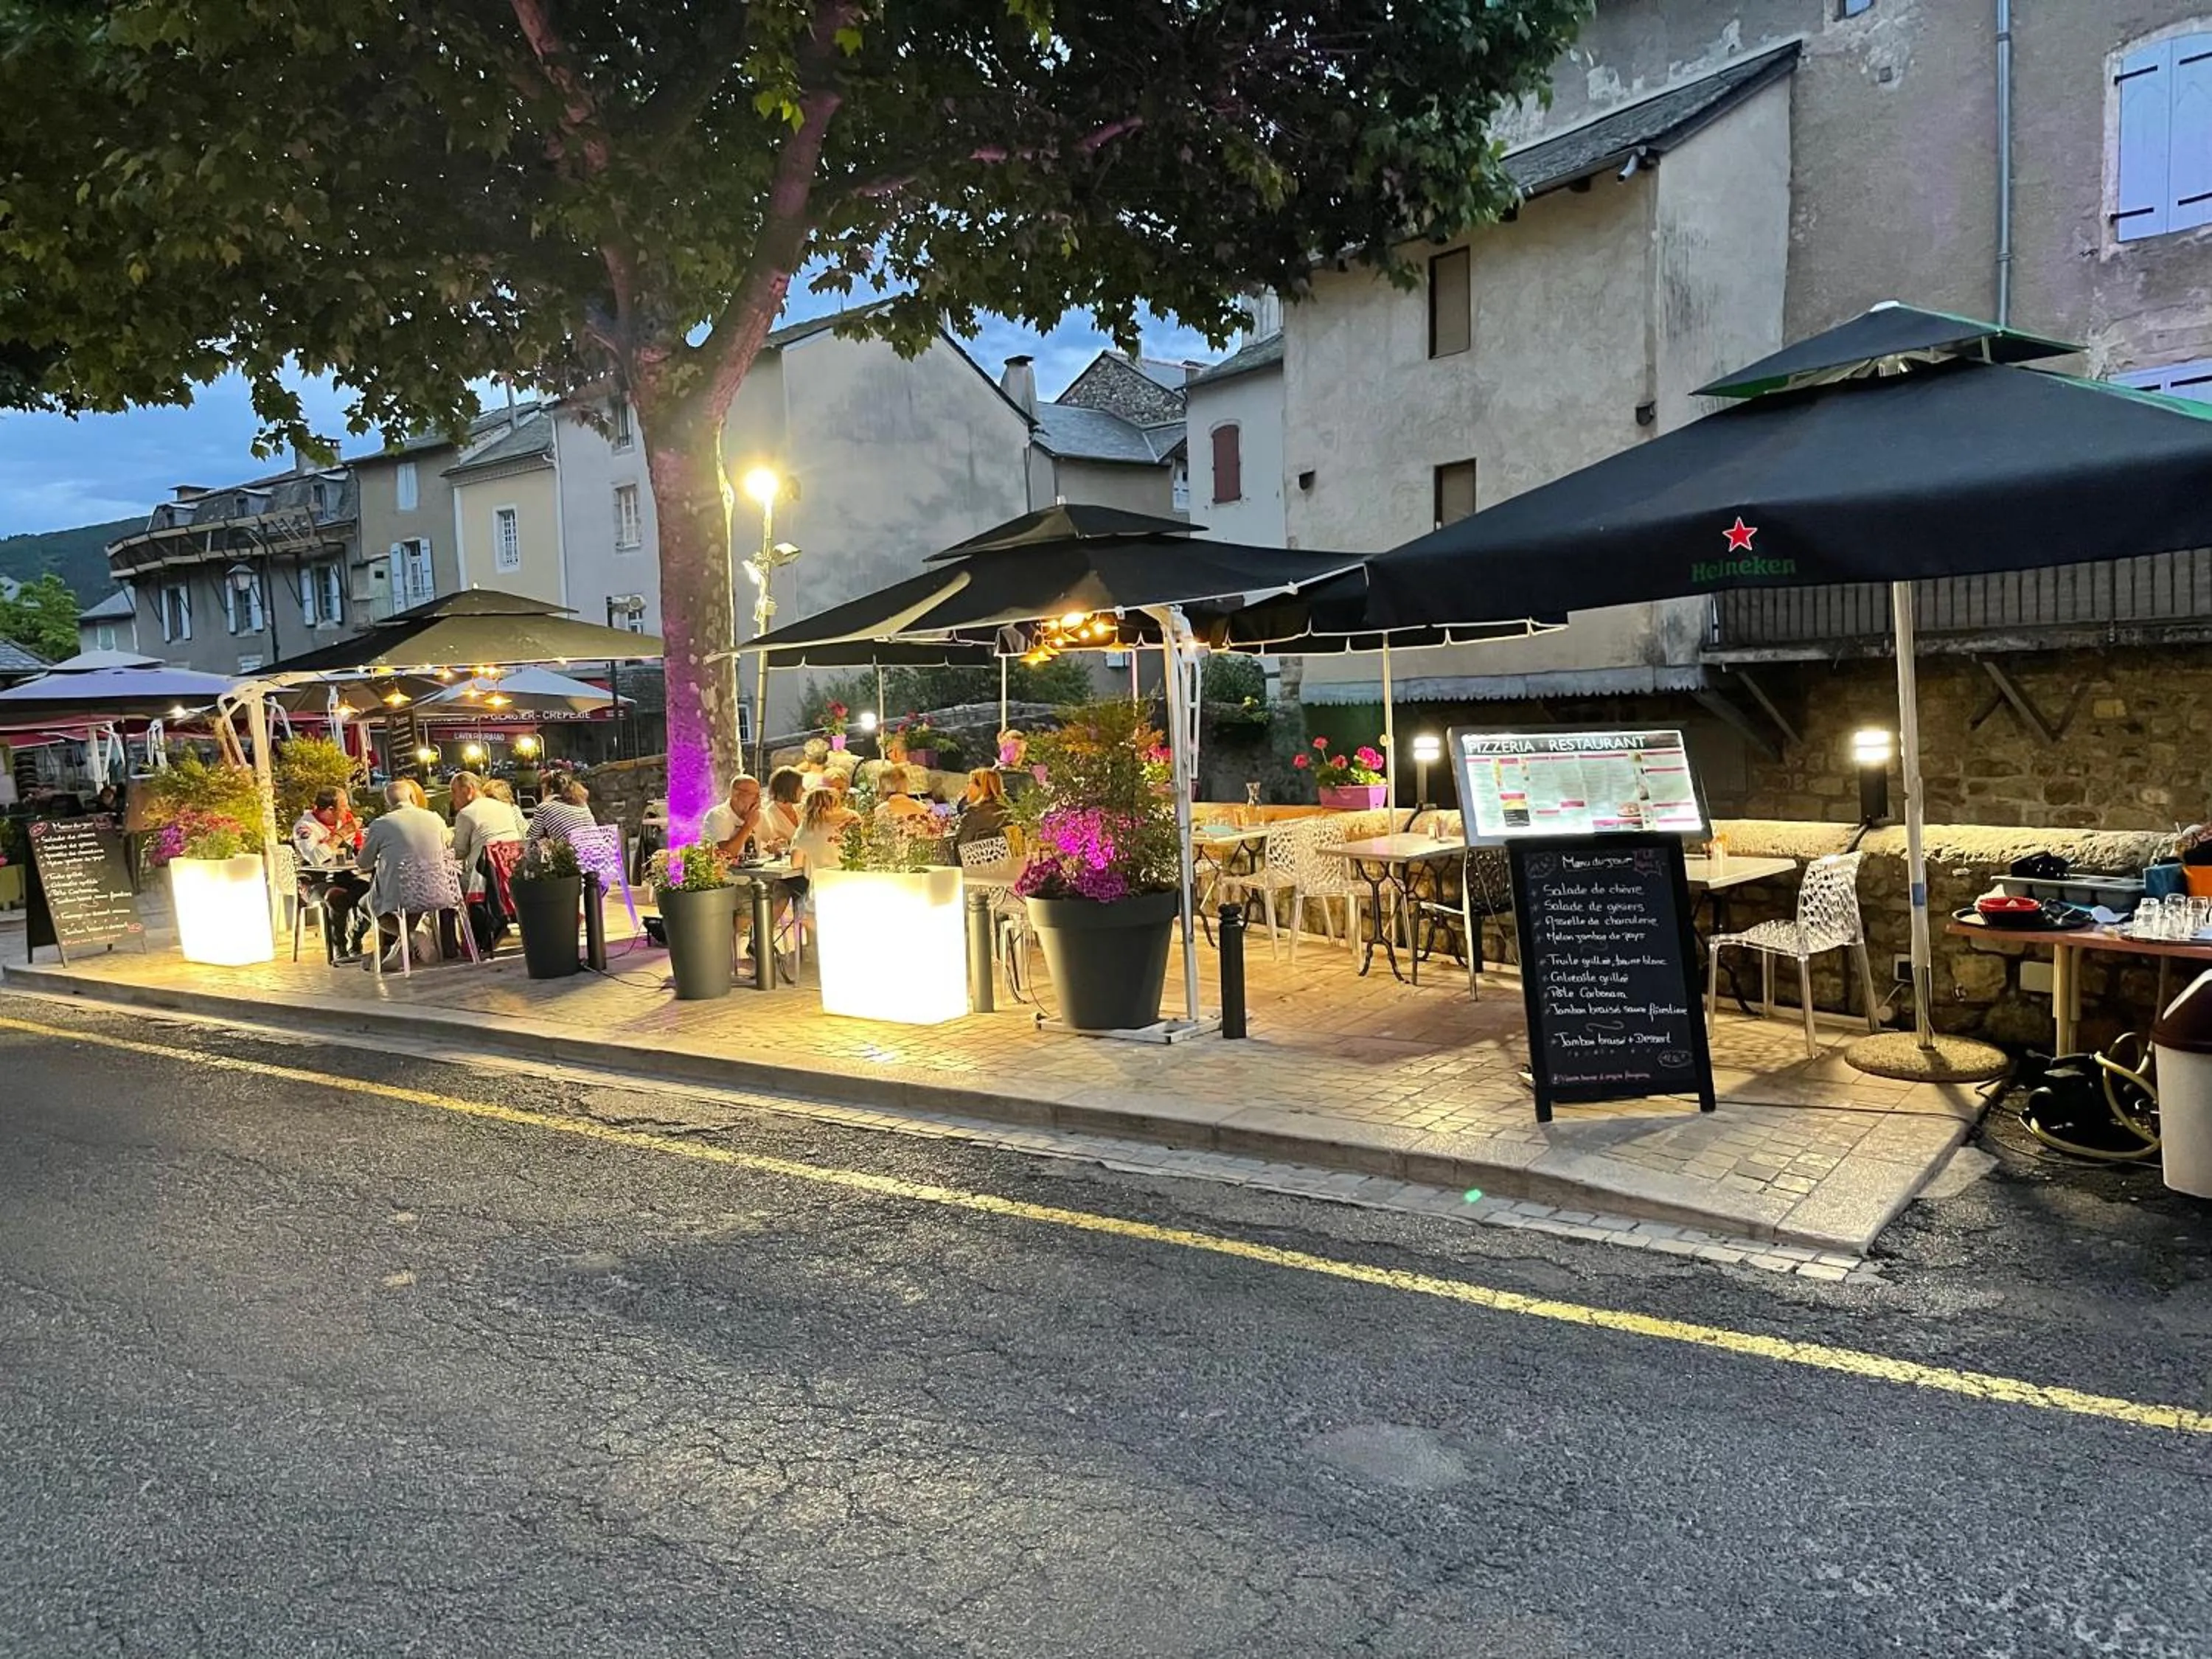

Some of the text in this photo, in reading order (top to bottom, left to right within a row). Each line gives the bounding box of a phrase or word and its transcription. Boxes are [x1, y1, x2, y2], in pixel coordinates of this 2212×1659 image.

[1691, 556, 1796, 582] Heineken
[1467, 736, 1647, 754] PIZZERIA RESTAURANT
[1543, 882, 1586, 896] Salade
[1590, 882, 1604, 894] de
[1544, 899, 1584, 912] Salade
[1588, 901, 1602, 912] de
[1587, 917, 1599, 925] de
[1608, 931, 1621, 940] de
[1545, 953, 1579, 965] Truite
